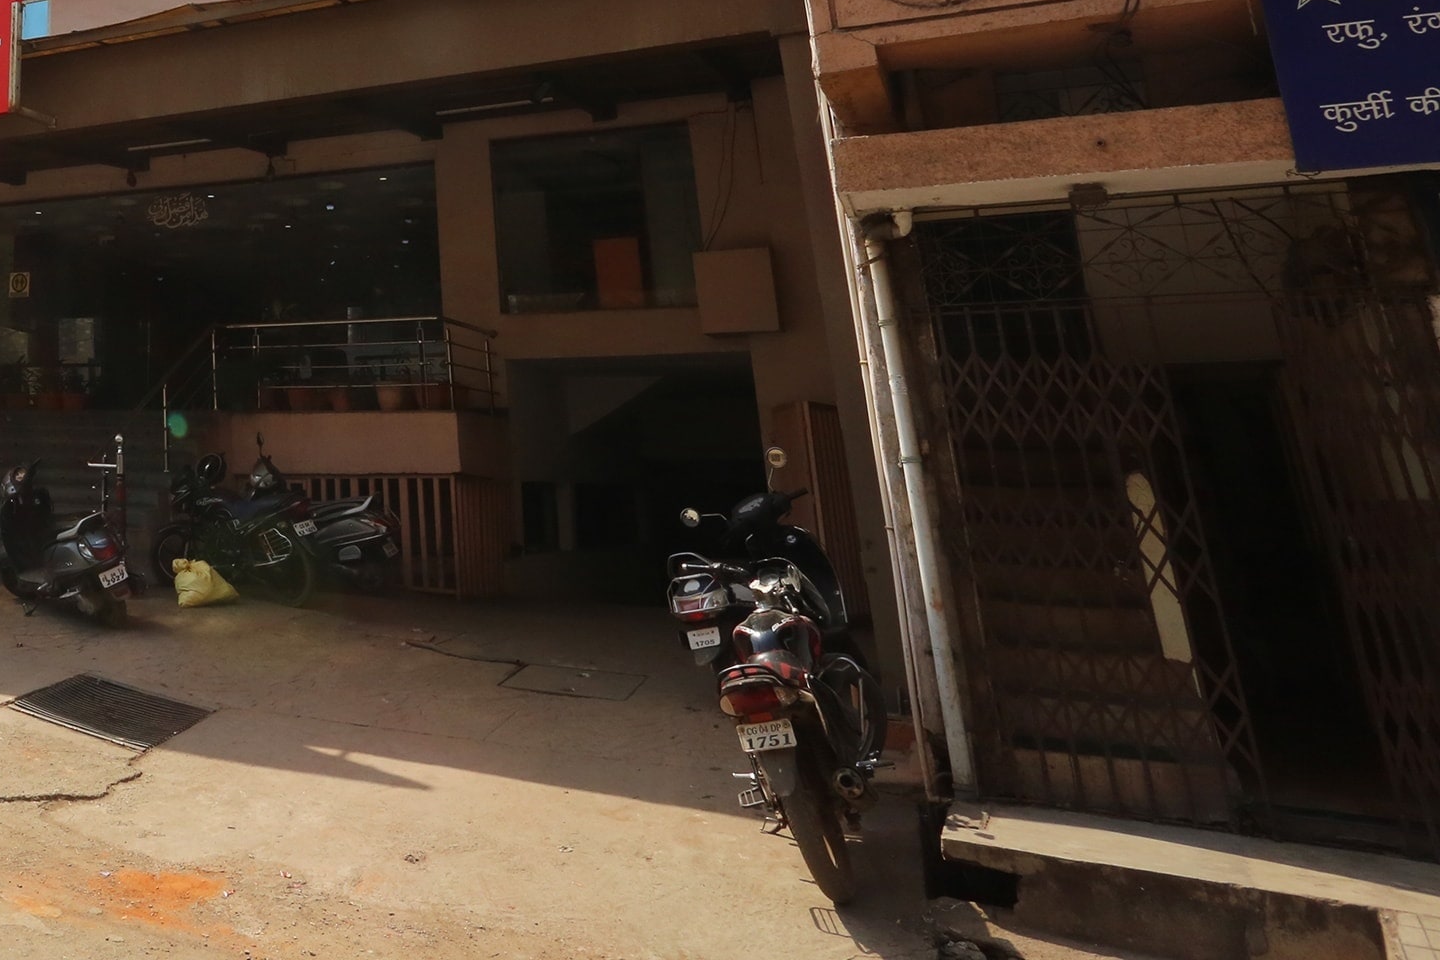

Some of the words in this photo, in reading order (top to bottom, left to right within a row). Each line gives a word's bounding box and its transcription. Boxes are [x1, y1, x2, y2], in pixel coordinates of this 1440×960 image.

[746, 726, 758, 736] CG
[770, 722, 781, 733] DP
[746, 733, 792, 750] 1751
